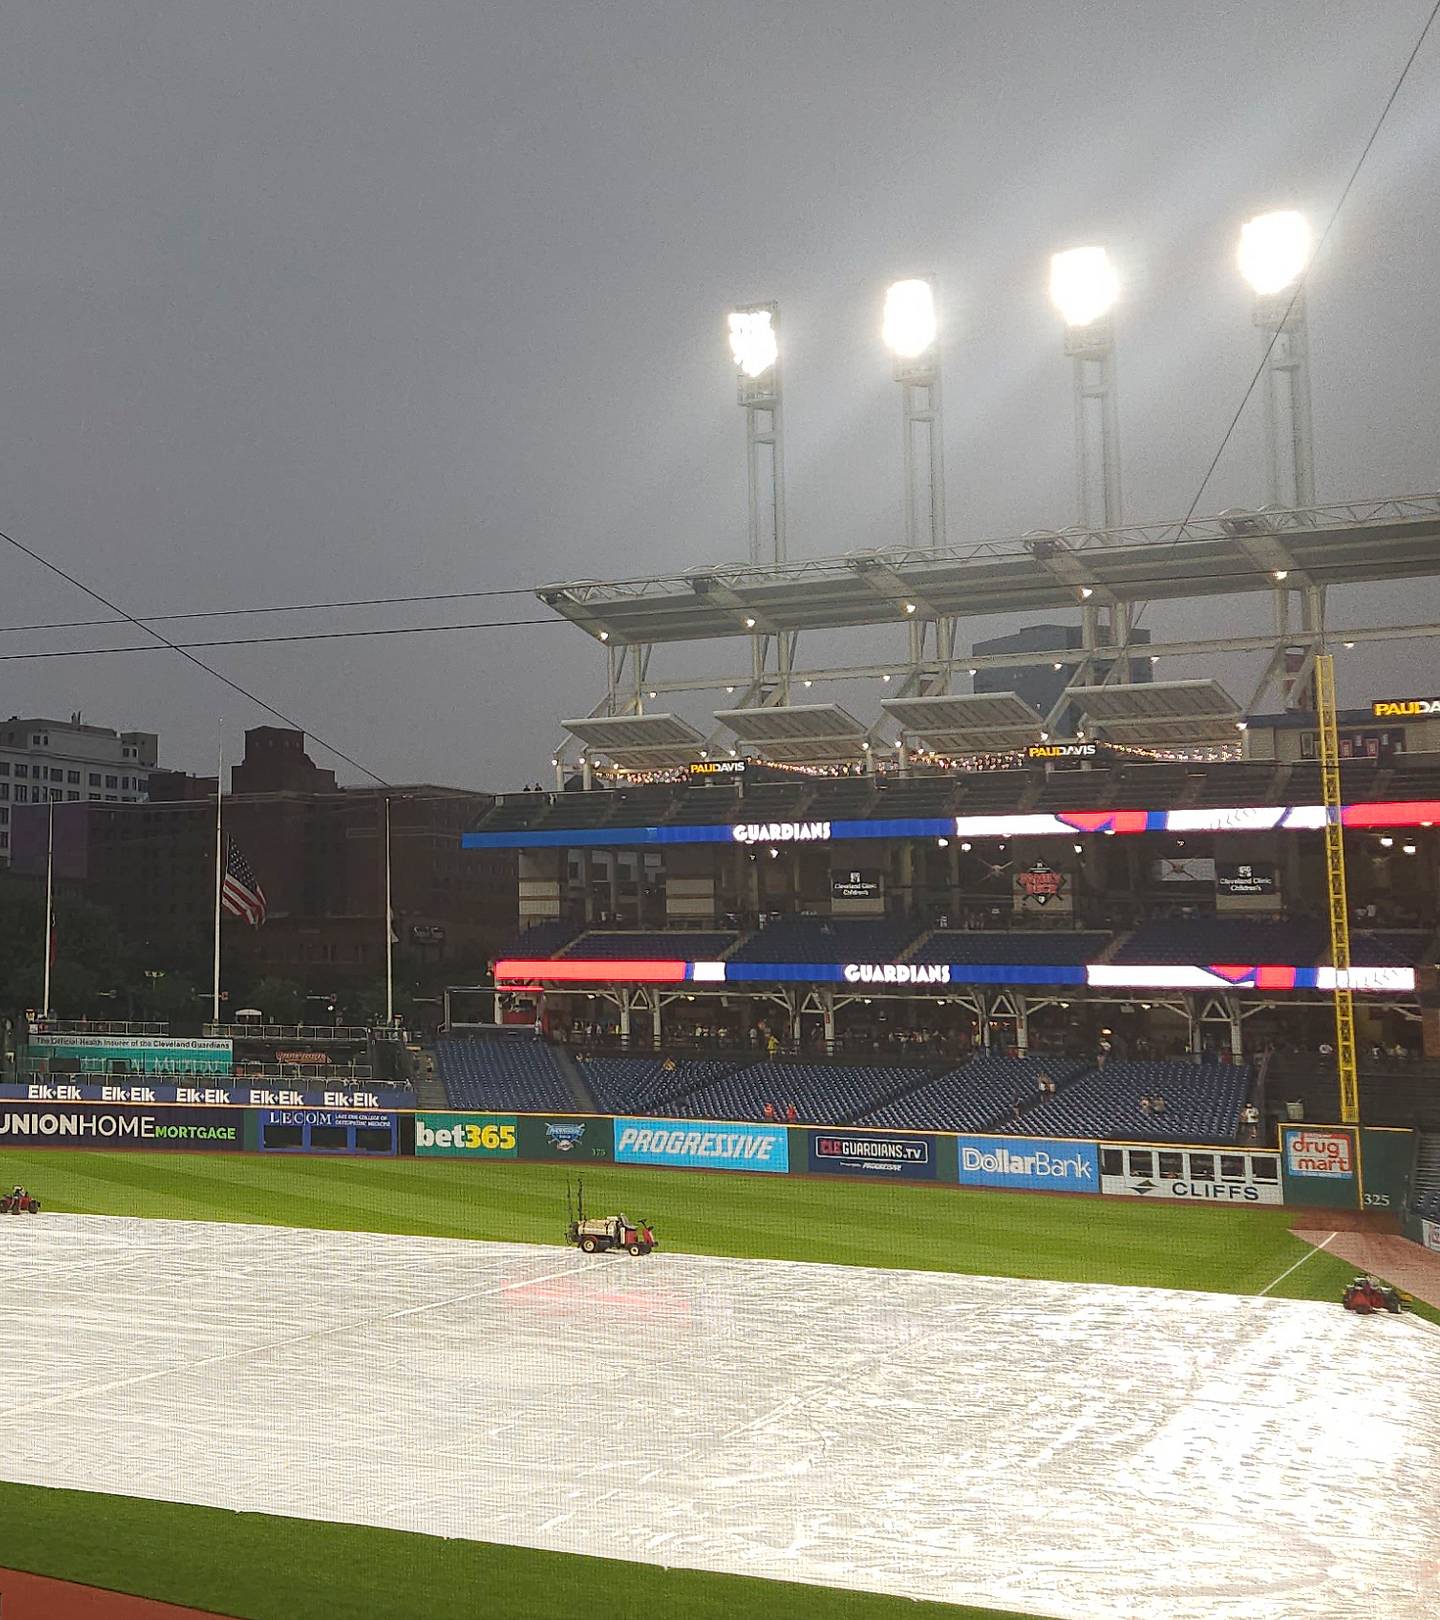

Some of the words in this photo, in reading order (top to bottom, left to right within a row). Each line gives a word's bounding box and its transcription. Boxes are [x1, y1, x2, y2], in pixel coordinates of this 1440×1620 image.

[733, 822, 831, 843] GUARDIANS
[844, 964, 951, 984] GUARDIANS
[153, 1040, 190, 1048] Cleveland
[191, 1041, 230, 1049] Guardians
[155, 1126, 236, 1140] MORTGAGE
[416, 1122, 516, 1149] bet365
[618, 1128, 777, 1160] PROGRESSIVE
[1293, 1136, 1340, 1158] drug
[1298, 1157, 1347, 1171] mart
[1172, 1181, 1259, 1200] CLIFFS
[1364, 1194, 1390, 1206] 325
